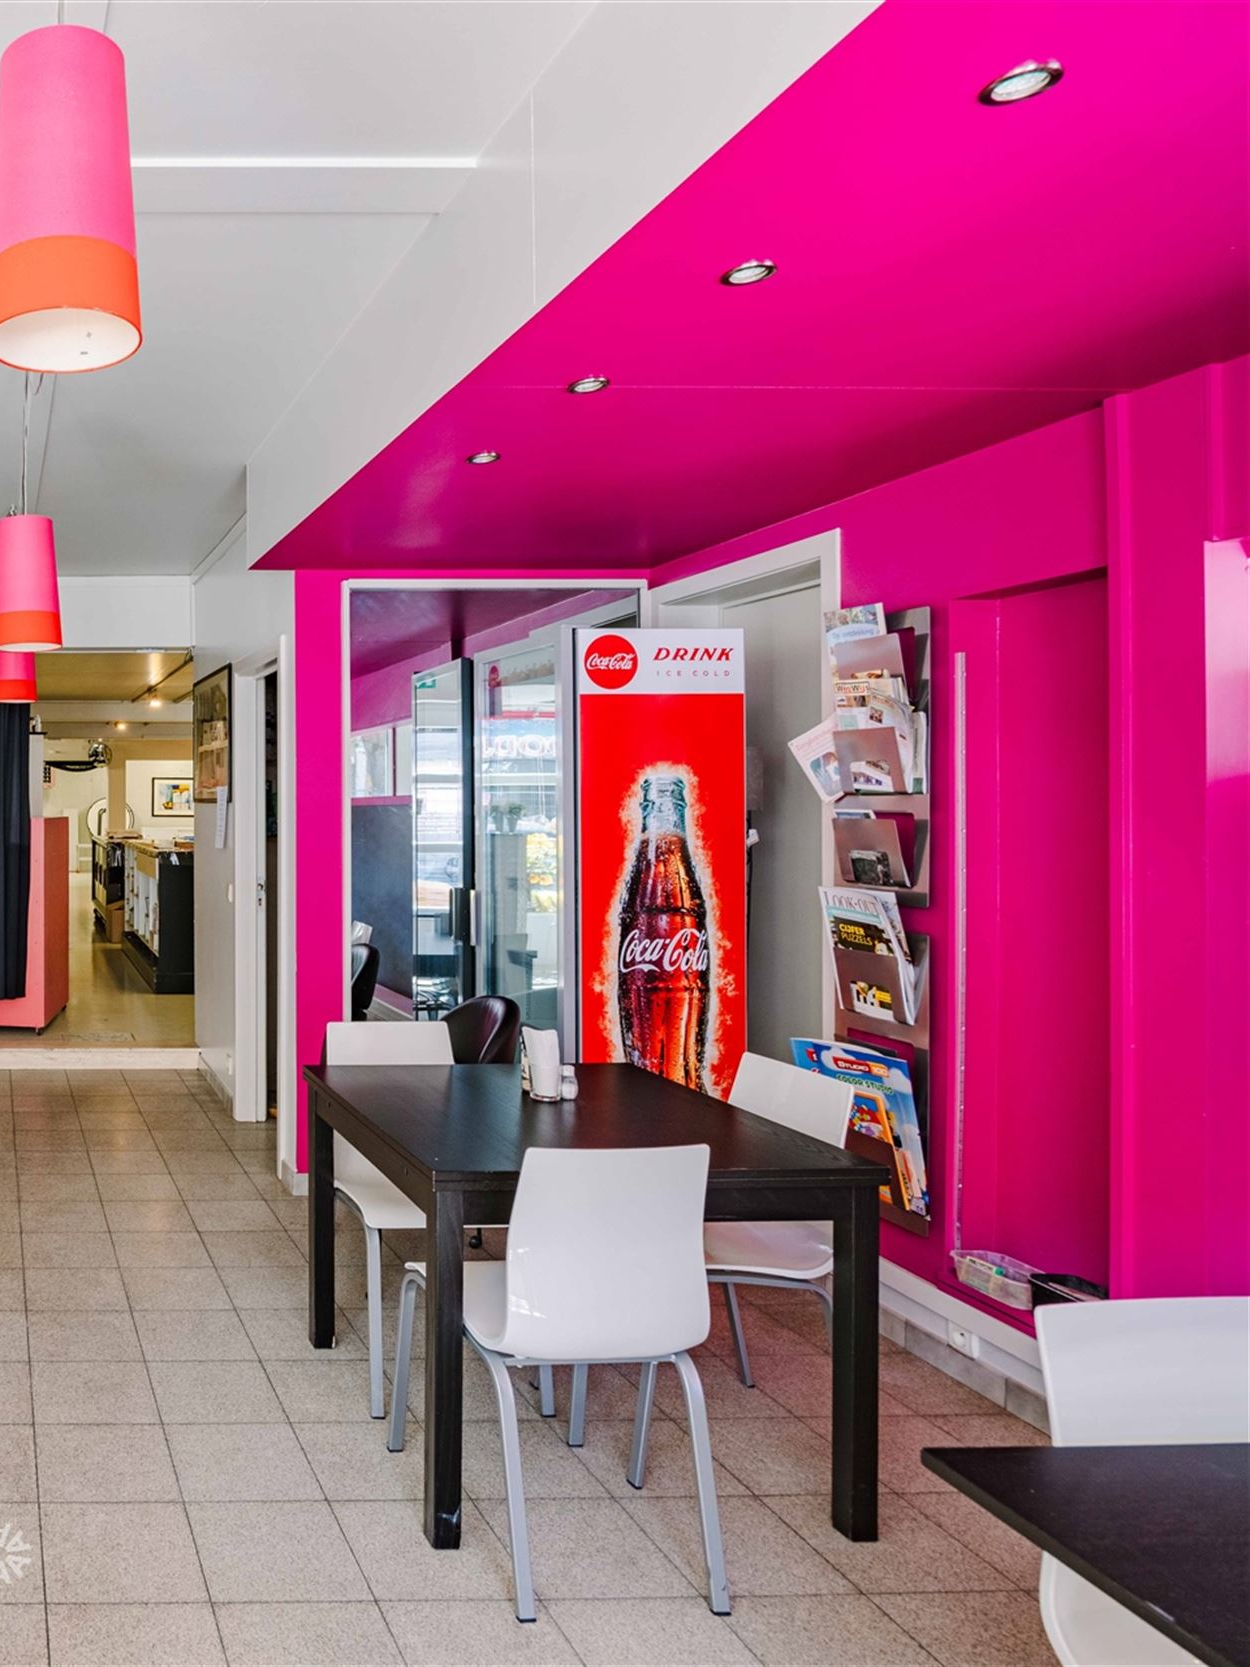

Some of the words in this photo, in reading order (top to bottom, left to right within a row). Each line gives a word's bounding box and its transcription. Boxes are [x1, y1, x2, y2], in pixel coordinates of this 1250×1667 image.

[586, 653, 637, 670] Coca-Cola
[653, 648, 734, 661] DRINK
[620, 928, 709, 973] Coca-Cola
[837, 1060, 869, 1072] STUDIO
